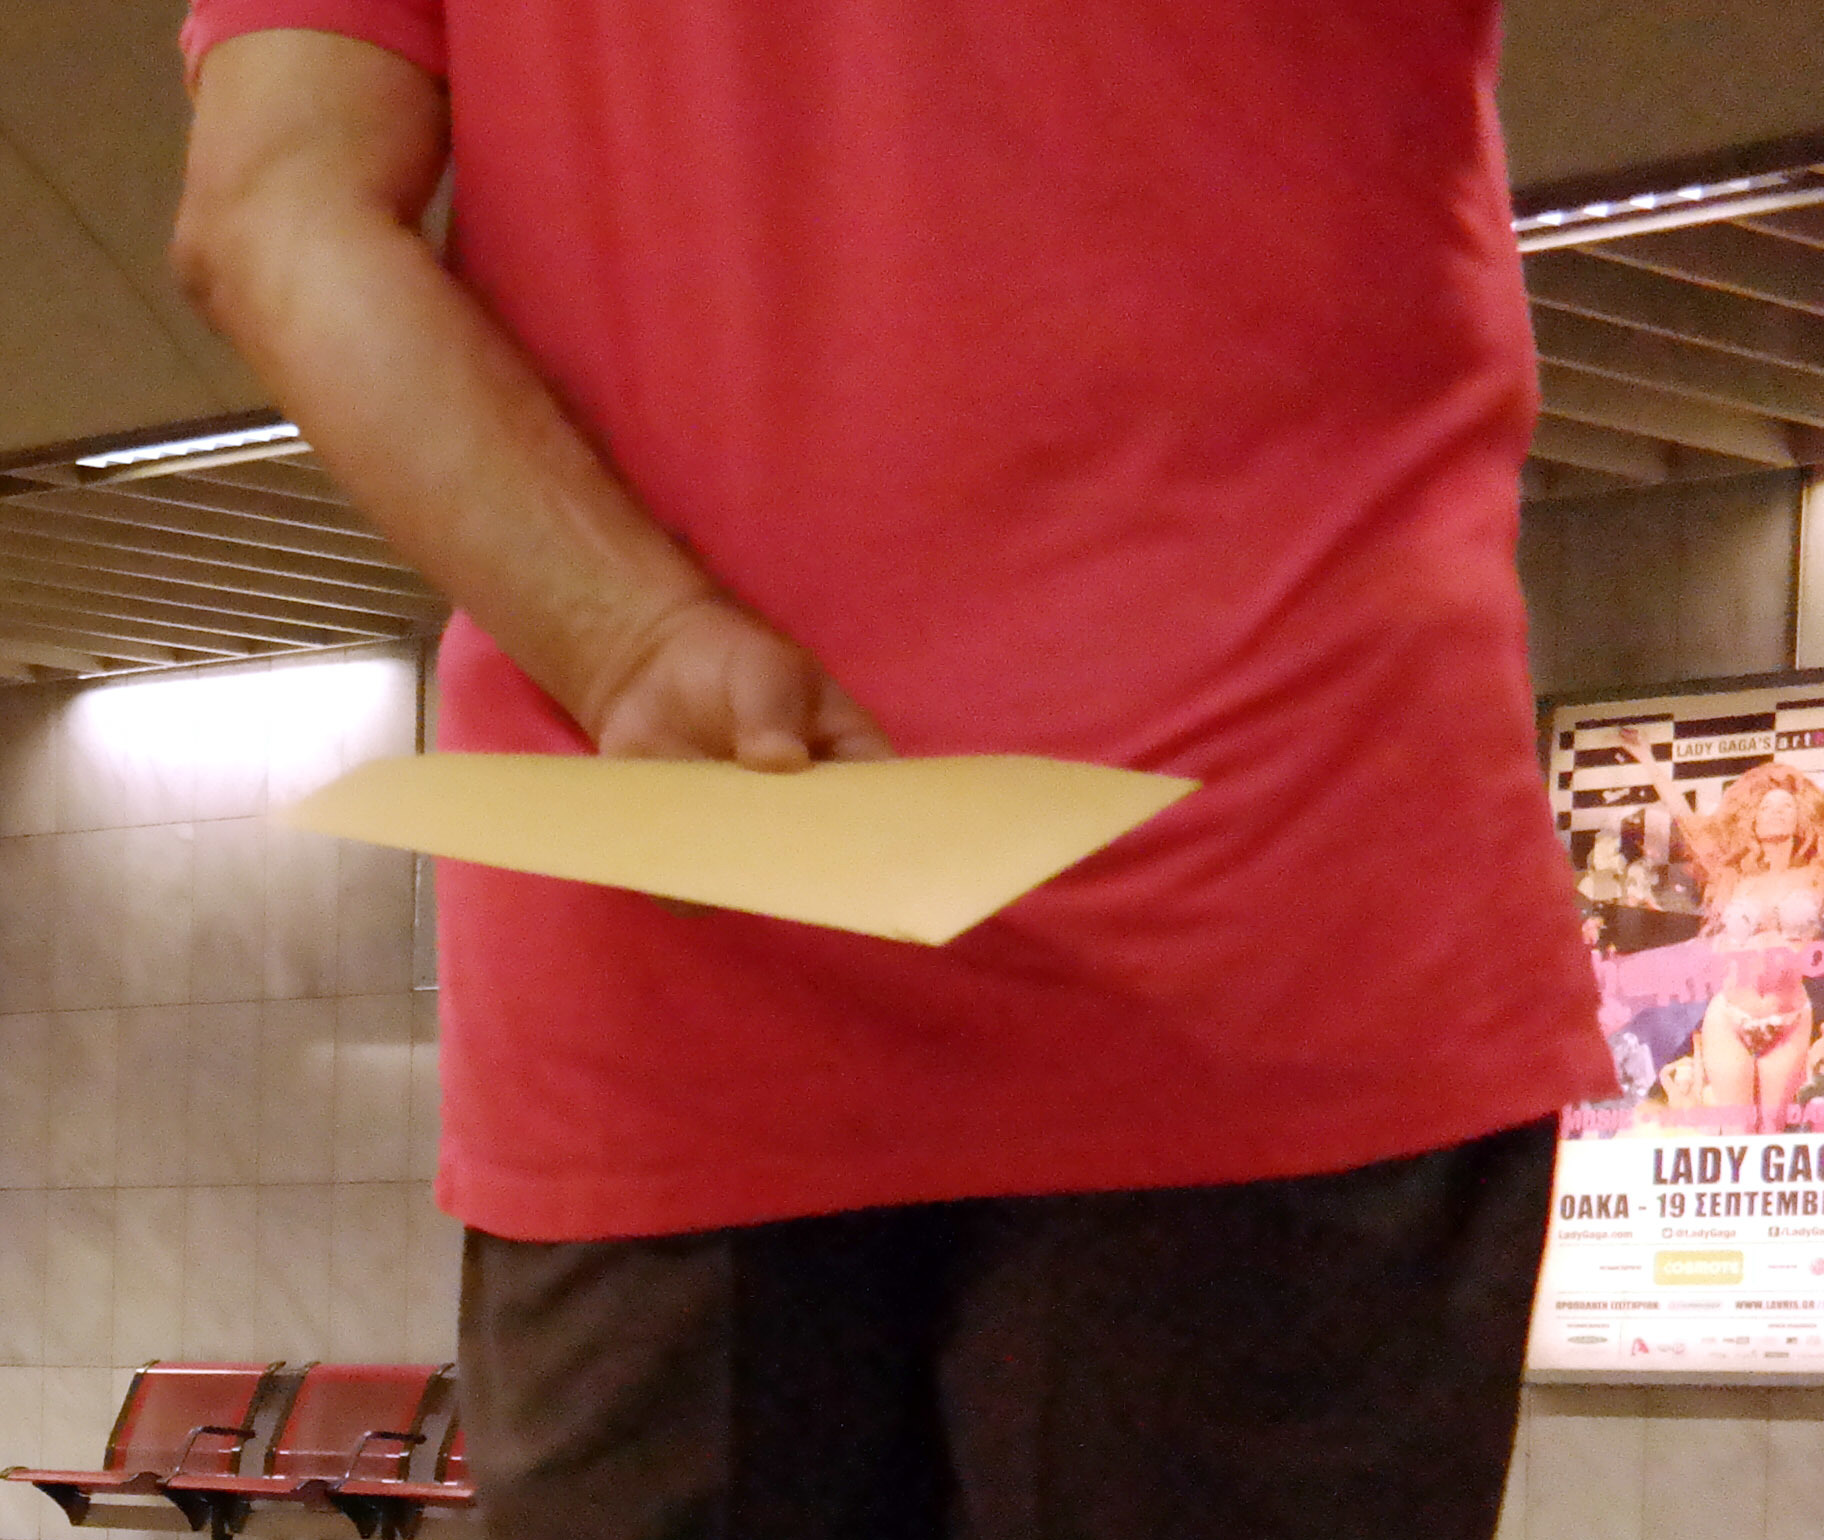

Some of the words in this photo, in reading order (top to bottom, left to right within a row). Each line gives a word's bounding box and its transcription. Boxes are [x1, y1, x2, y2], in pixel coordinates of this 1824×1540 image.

[1676, 742, 1712, 758] LADY
[1718, 736, 1771, 754] GAGA'S
[1777, 731, 1824, 749] art
[1652, 1145, 1749, 1186] LADY
[1559, 1193, 1631, 1221] ΟΑΚΑ
[1656, 1191, 1686, 1218] 19
[1694, 1189, 1824, 1218] ΣΕΠΤΕΜΒ
[1558, 1229, 1633, 1241] LadyGaga.com
